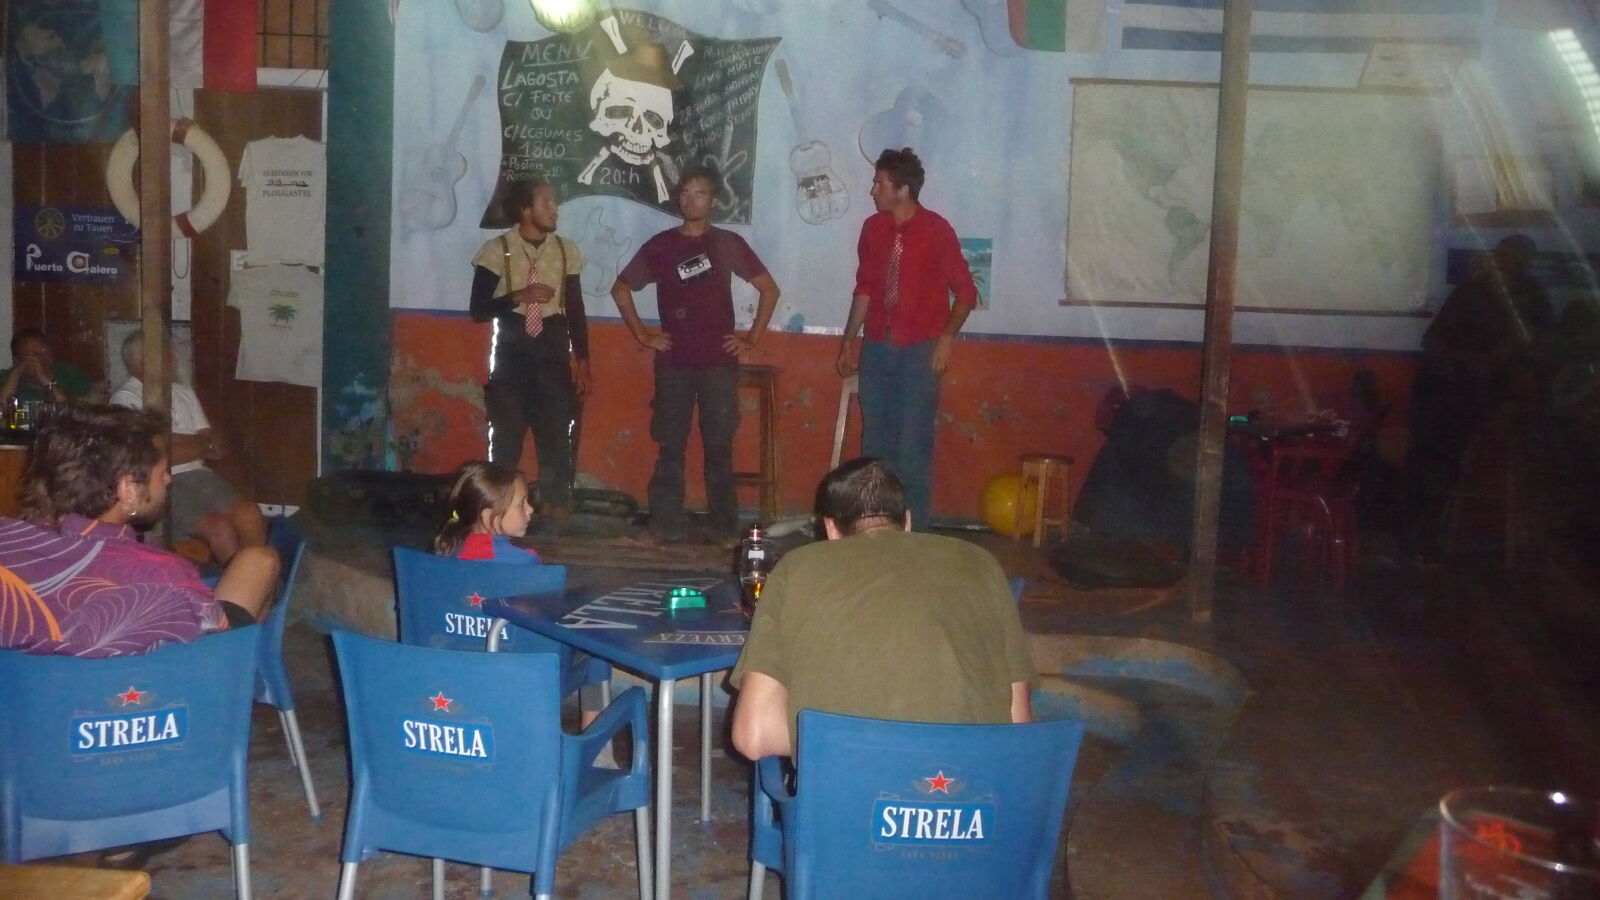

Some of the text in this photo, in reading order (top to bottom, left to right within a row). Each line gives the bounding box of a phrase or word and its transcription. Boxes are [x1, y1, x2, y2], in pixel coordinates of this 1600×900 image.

[521, 39, 593, 64] MENU
[501, 61, 579, 90] LAGOSTA
[727, 56, 762, 76] MUSIC
[519, 140, 566, 159] 1860
[71, 213, 115, 224] Vertrauen
[73, 224, 84, 233] zu
[25, 243, 63, 271] Puerto
[78, 712, 180, 749] STRELA
[403, 719, 488, 758] STRELA
[881, 806, 984, 840] STRELA
